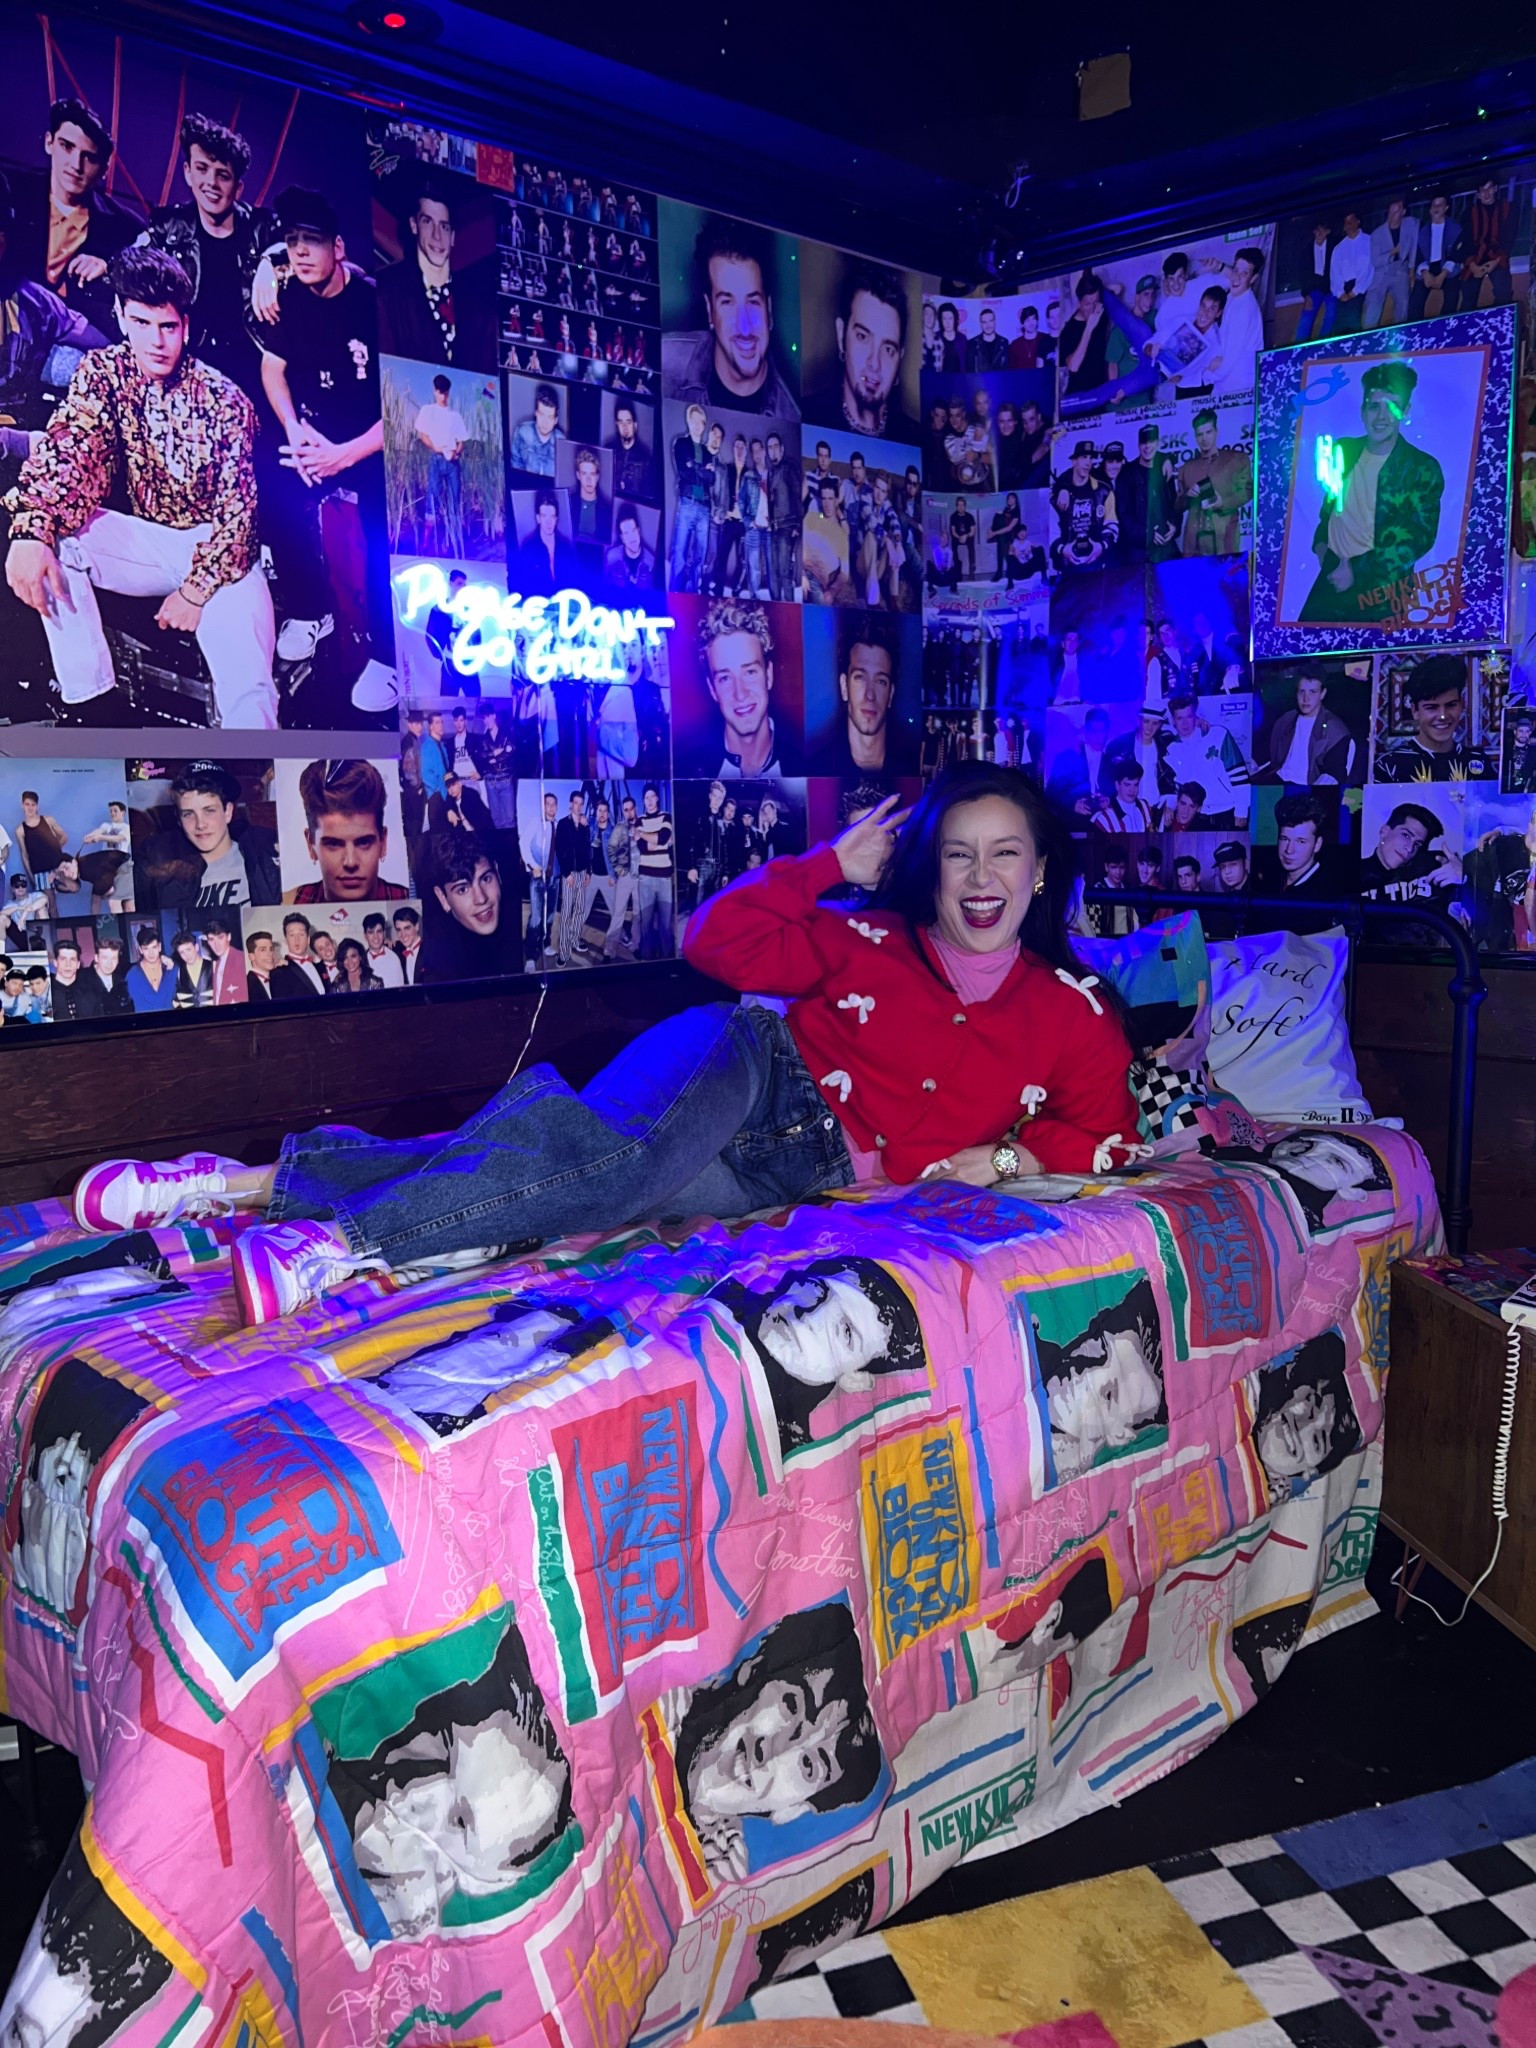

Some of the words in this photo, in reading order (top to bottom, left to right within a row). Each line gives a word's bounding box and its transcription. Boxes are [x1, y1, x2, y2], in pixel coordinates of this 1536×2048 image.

[1289, 364, 1351, 420] JOE
[1357, 581, 1396, 610] NEW
[1340, 1108, 1355, 1123] II
[640, 1407, 680, 1497] NEW
[922, 1438, 955, 1512] NEW
[162, 1460, 279, 1635] BLOCK
[246, 1490, 325, 1604] THE
[264, 1448, 366, 1575] KIDS
[645, 1502, 688, 1636] KIDS
[883, 1483, 919, 1650] BLOCK
[921, 1802, 972, 1857] NEW
